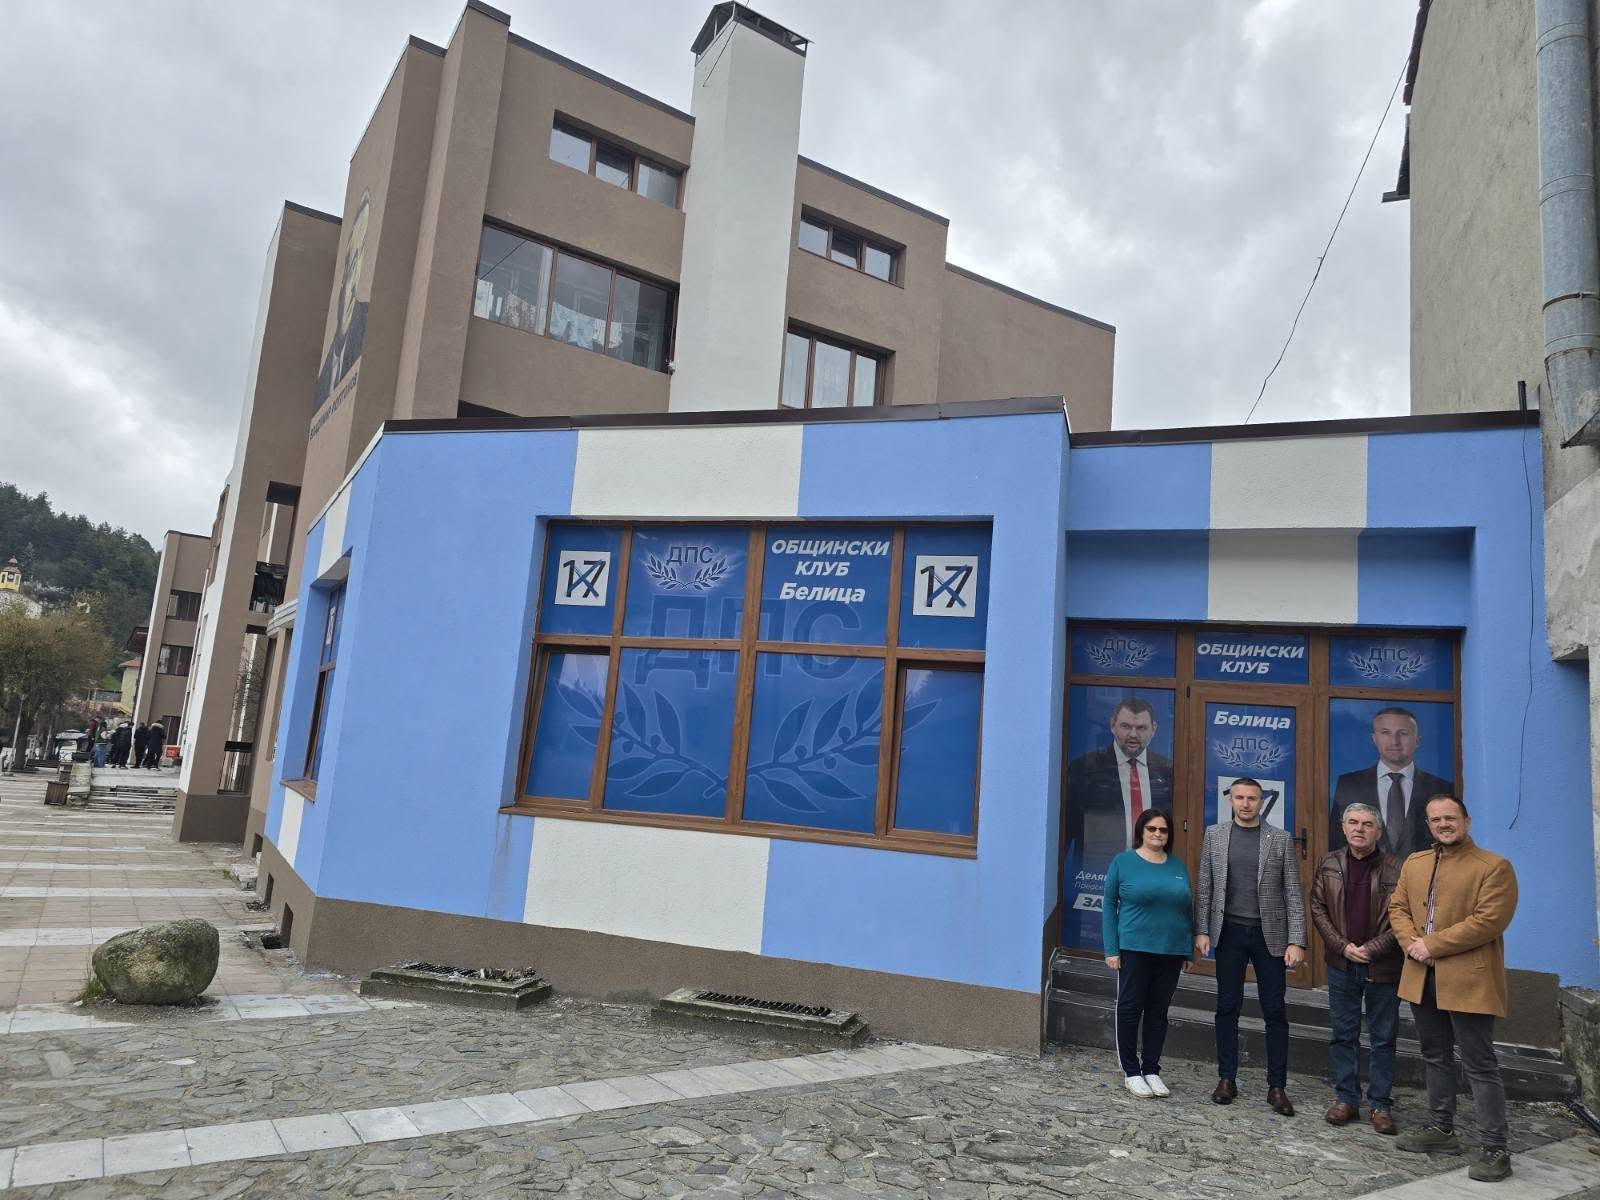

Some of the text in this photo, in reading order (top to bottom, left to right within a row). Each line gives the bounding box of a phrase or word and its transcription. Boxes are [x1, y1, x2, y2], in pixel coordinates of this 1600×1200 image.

[666, 546, 715, 566] ДПС
[771, 539, 890, 557] ОБЩИНСКИ
[795, 560, 850, 577] КЛУБ
[563, 559, 607, 598] 17
[920, 564, 974, 608] 17
[779, 582, 866, 604] Белица
[634, 594, 862, 689] ДПС
[1102, 638, 1139, 652] ДПС
[1197, 643, 1305, 659] ОБЩИНСКИ
[1368, 647, 1409, 662] ДПС
[1220, 660, 1270, 674] КЛУБ
[1213, 711, 1291, 730] Белица
[1231, 737, 1270, 751] ДПС
